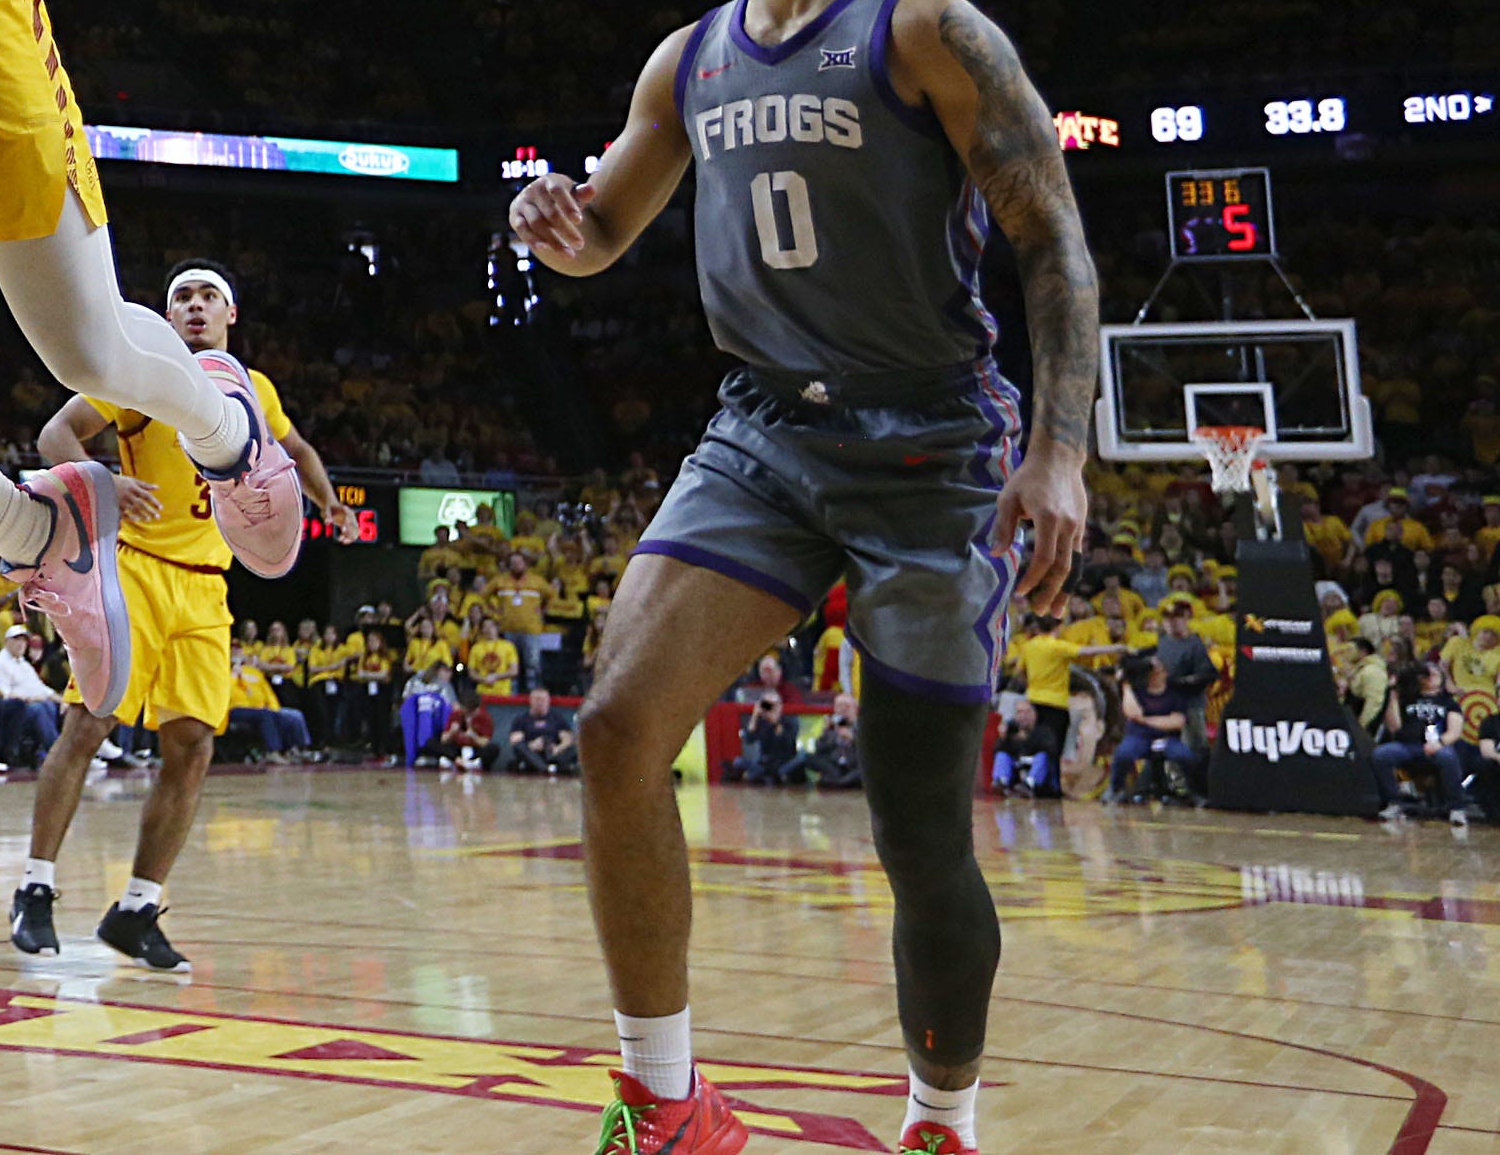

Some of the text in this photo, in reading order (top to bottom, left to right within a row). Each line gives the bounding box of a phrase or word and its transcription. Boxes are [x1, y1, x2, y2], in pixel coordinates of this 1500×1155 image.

[696, 93, 863, 161] FROGS
[1151, 105, 1202, 142] 69
[1264, 98, 1345, 135] 33.8
[750, 170, 818, 270] 0
[1222, 203, 1256, 251] 5
[337, 485, 365, 505] TCU
